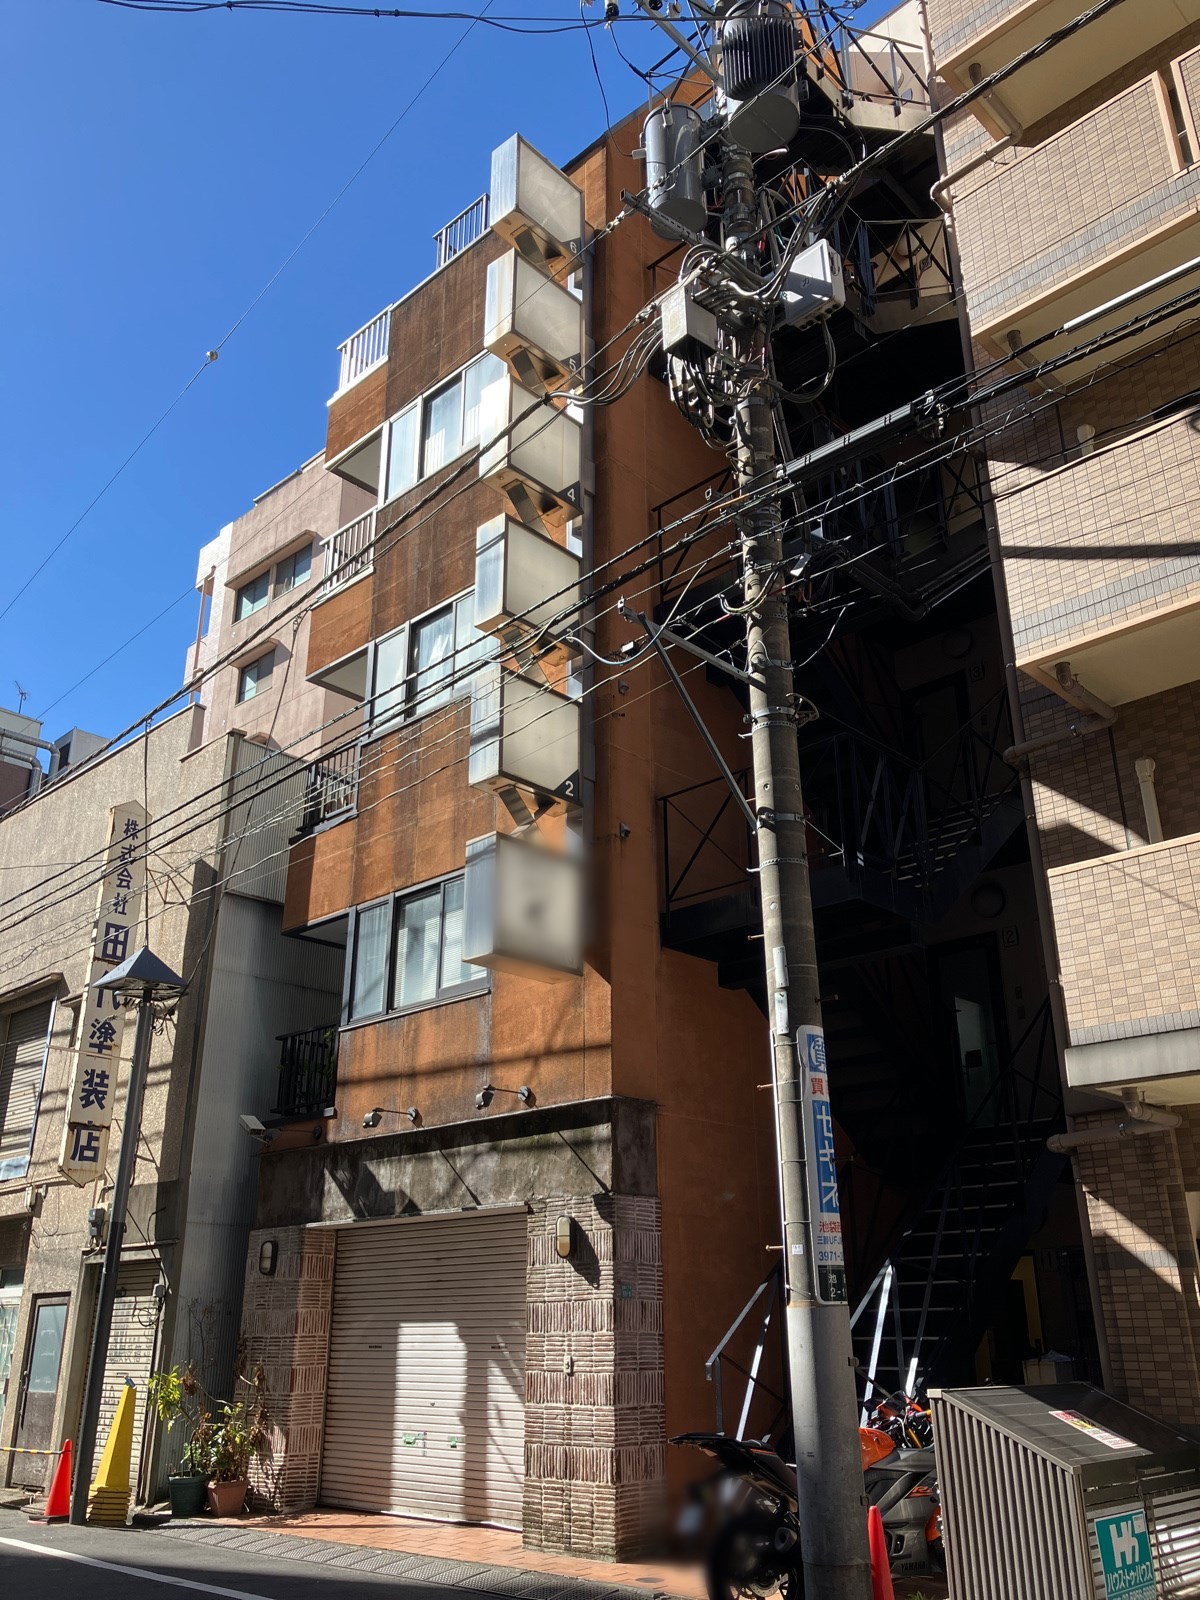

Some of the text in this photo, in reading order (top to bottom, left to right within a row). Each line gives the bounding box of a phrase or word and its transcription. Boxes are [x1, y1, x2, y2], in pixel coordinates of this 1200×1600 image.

[569, 241, 577, 254] 6
[569, 358, 576, 371] 5
[567, 487, 576, 502] 4
[564, 780, 574, 797] 2
[900, 1561, 926, 1571] YAMAHA
